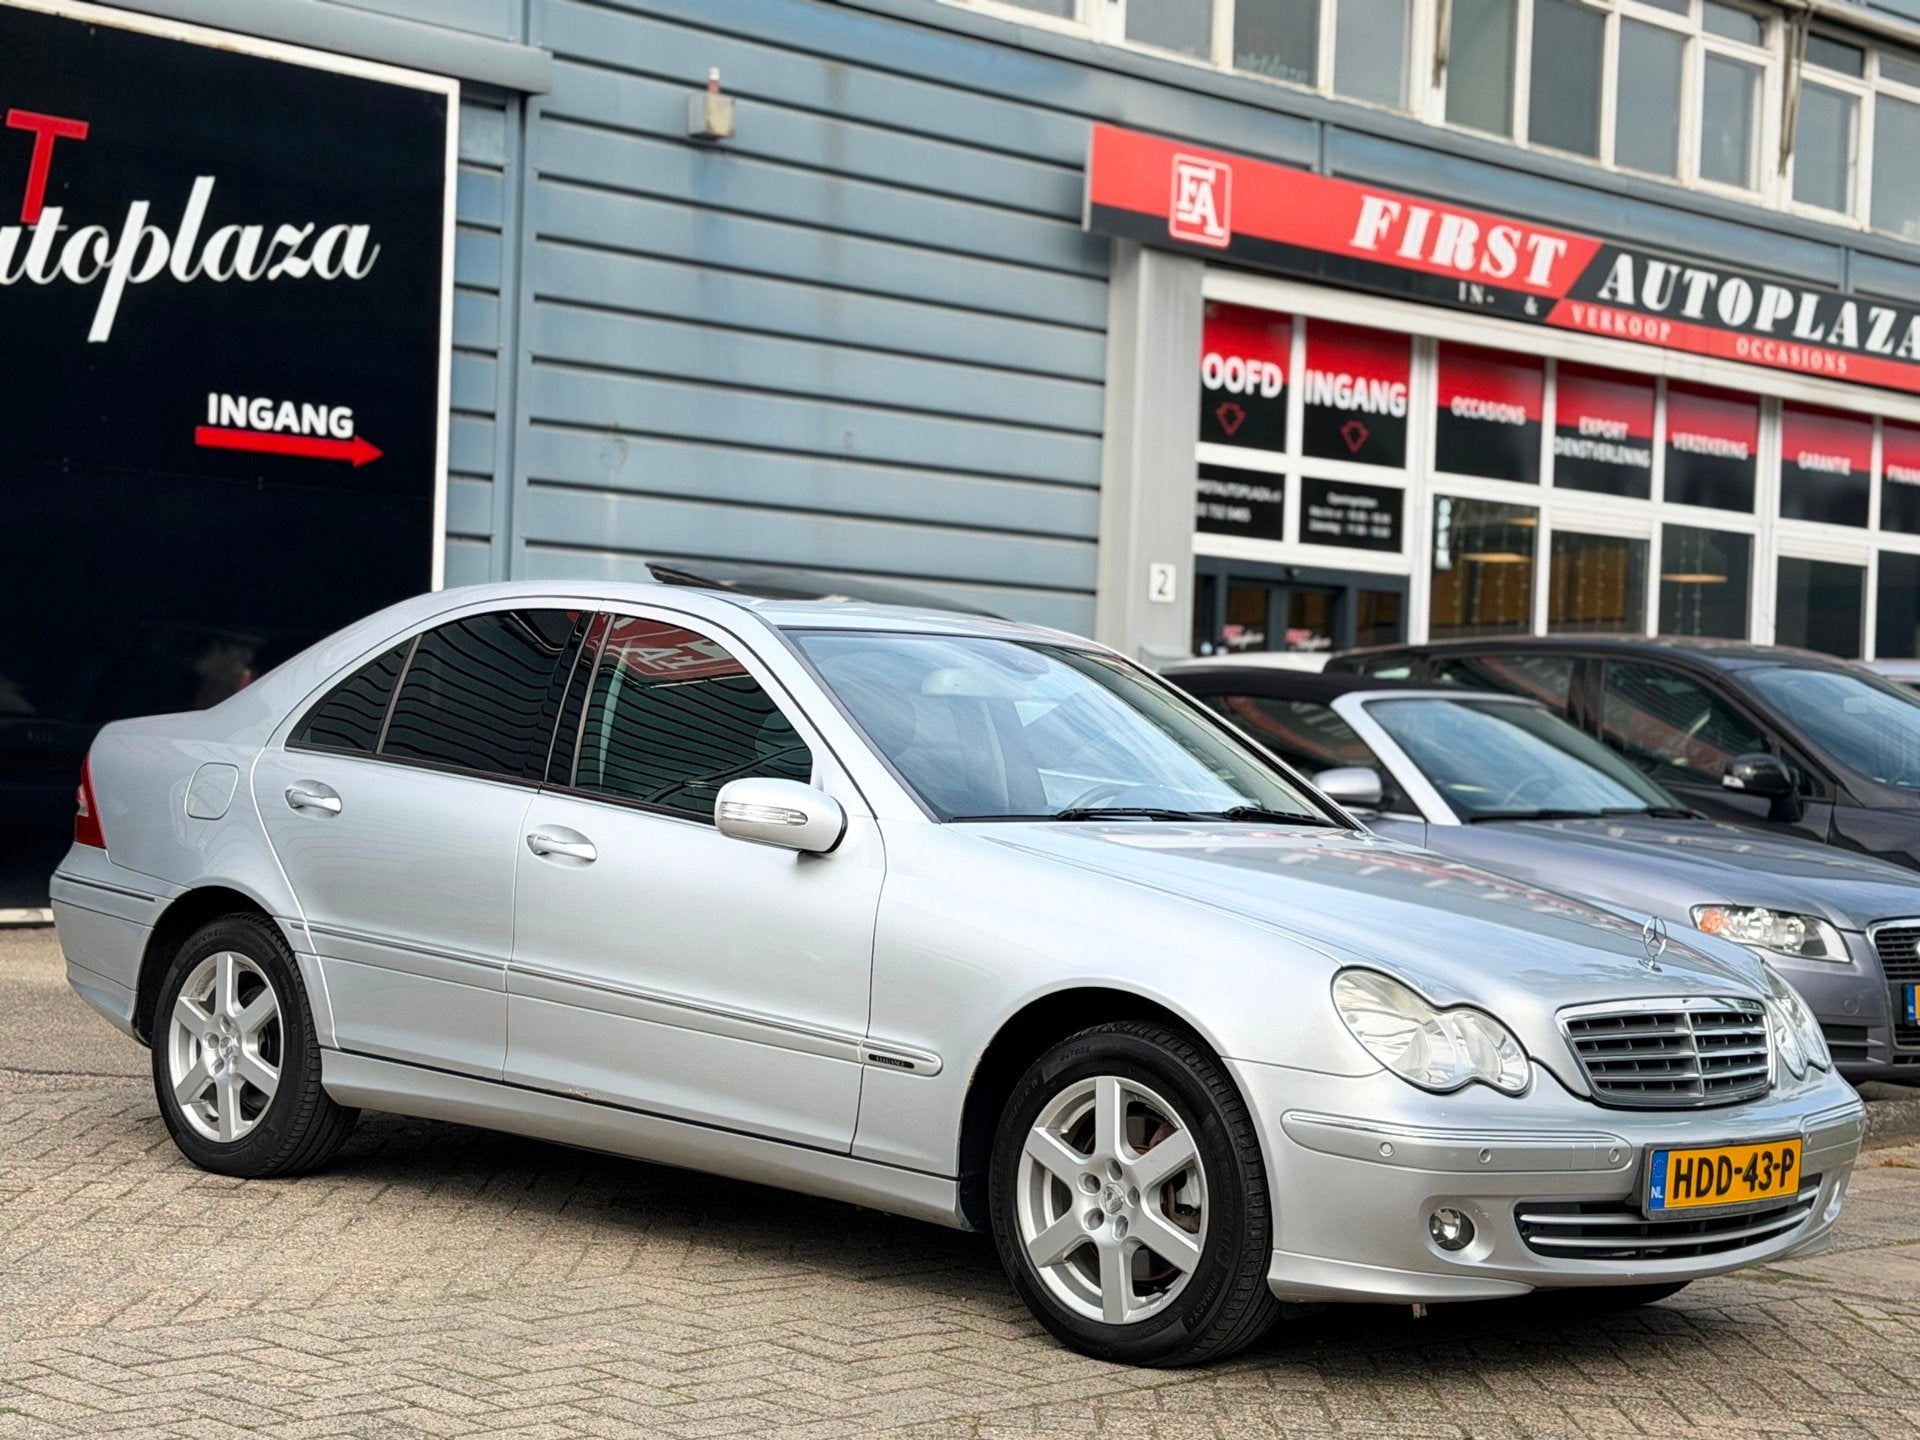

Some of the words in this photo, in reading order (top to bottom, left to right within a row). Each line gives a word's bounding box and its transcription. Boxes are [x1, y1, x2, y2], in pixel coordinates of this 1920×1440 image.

[1348, 194, 1567, 288] FIRST
[1597, 253, 1920, 361] AUTOPLAZA
[1524, 295, 1538, 316] &
[1571, 304, 1672, 342] VERKOOP
[1735, 336, 1848, 374] OCCASIONS
[207, 393, 354, 438] INGANG
[1304, 369, 1407, 418] INGANG
[1451, 395, 1526, 427] OCCASIONS
[1578, 415, 1629, 441] EXPORT
[1157, 569, 1168, 595] 2
[1651, 1186, 1663, 1199] NL
[1673, 1148, 1794, 1200] HDD-43-P
